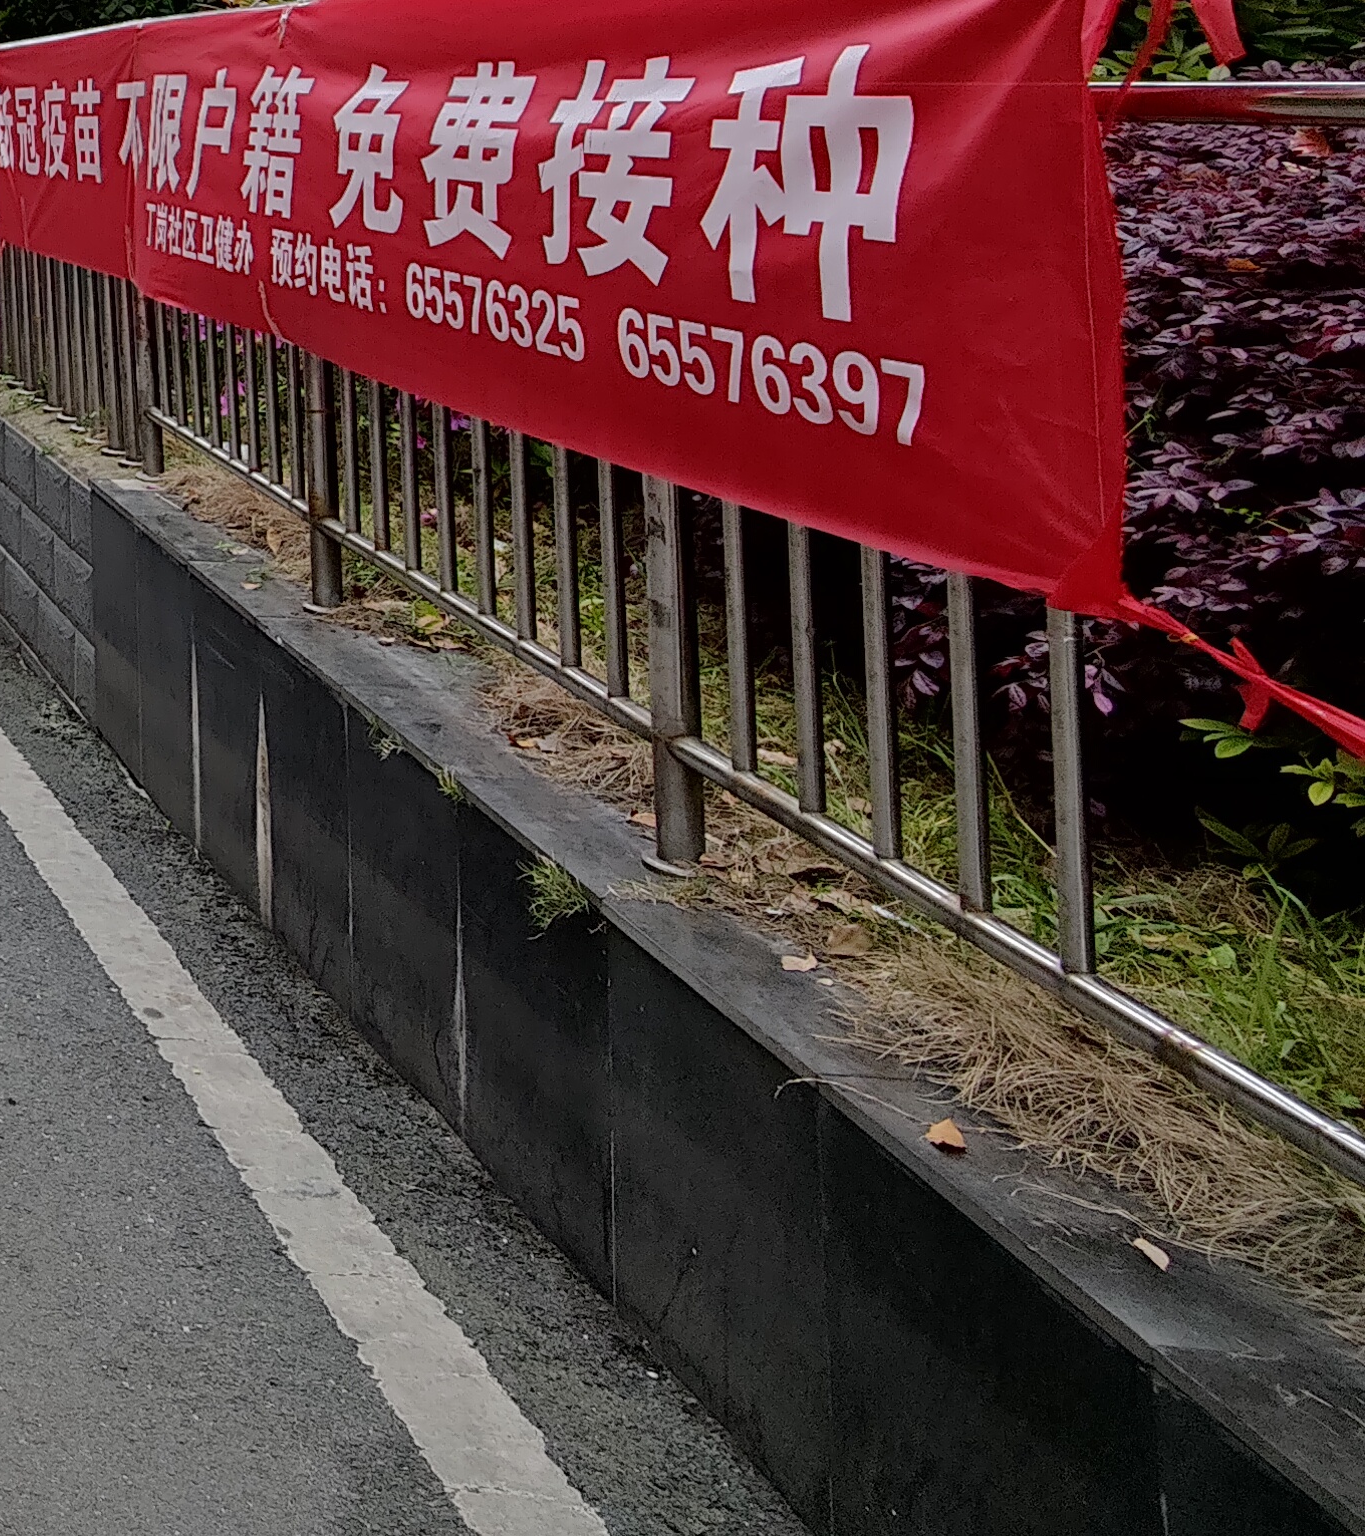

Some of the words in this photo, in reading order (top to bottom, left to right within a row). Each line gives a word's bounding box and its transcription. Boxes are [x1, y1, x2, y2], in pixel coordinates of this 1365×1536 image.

[116, 65, 315, 220] 不限户籍
[329, 44, 914, 322] 免费接种
[145, 202, 254, 276] 丁岗社区卫健办
[405, 262, 585, 362] 65576325
[617, 307, 926, 447] 65576397
